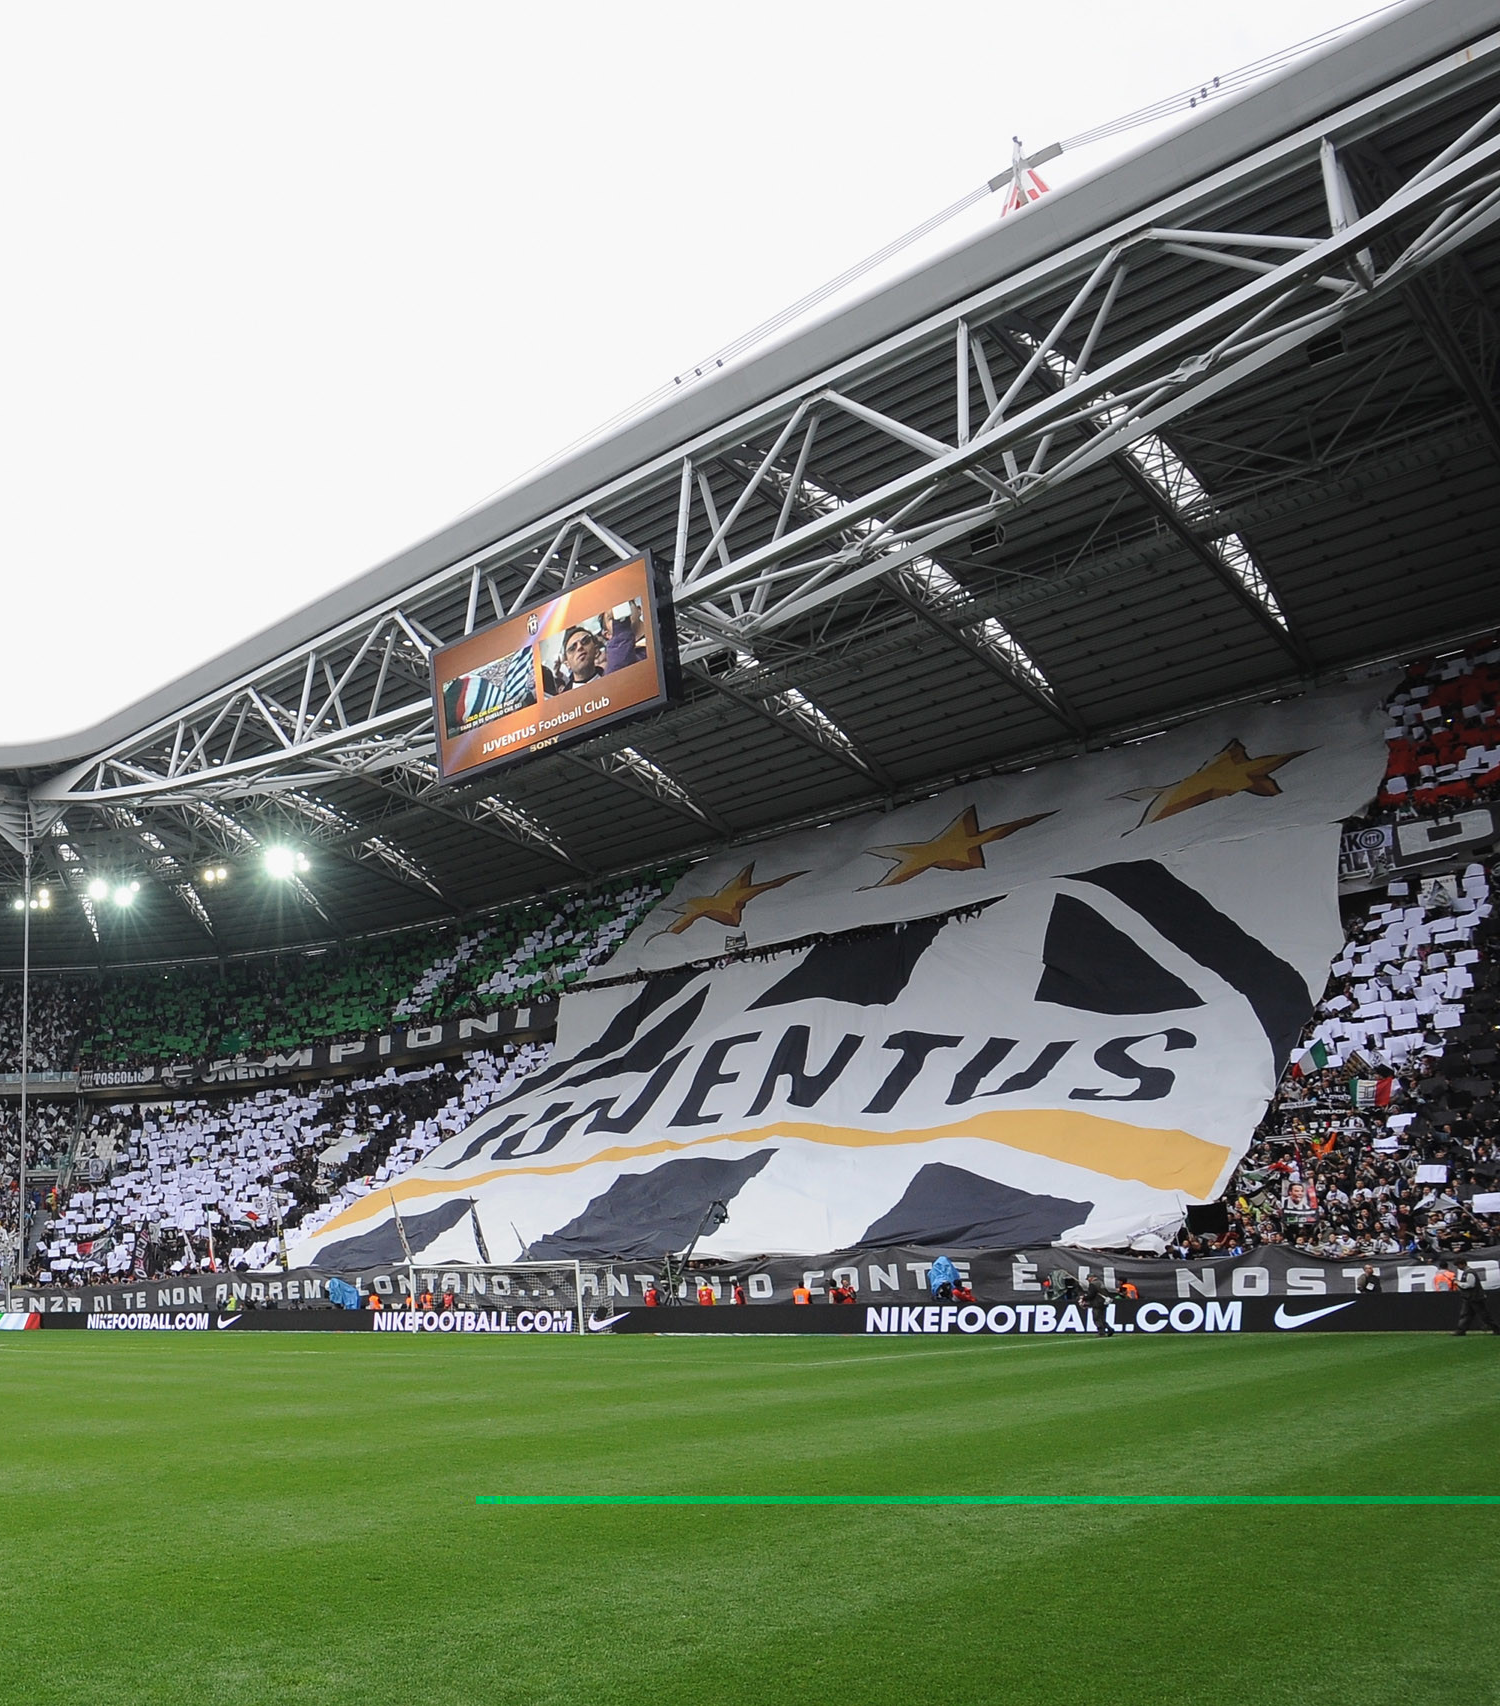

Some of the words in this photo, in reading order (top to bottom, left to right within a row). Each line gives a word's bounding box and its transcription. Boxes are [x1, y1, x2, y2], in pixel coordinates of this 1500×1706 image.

[482, 724, 537, 755] JUVENTUS
[538, 705, 582, 732] Football
[584, 696, 610, 716] Club
[529, 735, 560, 753] SONY
[424, 1024, 1197, 1169] JUVENTUS
[94, 1294, 113, 1311] DI
[122, 1291, 147, 1310] TE
[158, 1286, 202, 1307] NON
[215, 1279, 331, 1305] ANDREM
[580, 1273, 774, 1299] ANTNIO
[1012, 1254, 1041, 1291] È
[86, 1312, 209, 1331] NIKEFOOTBALL.COM
[373, 1310, 573, 1333] NIKEFOOTBALL.COM
[866, 1301, 1242, 1333] NIKEFOOTBALL.COM
